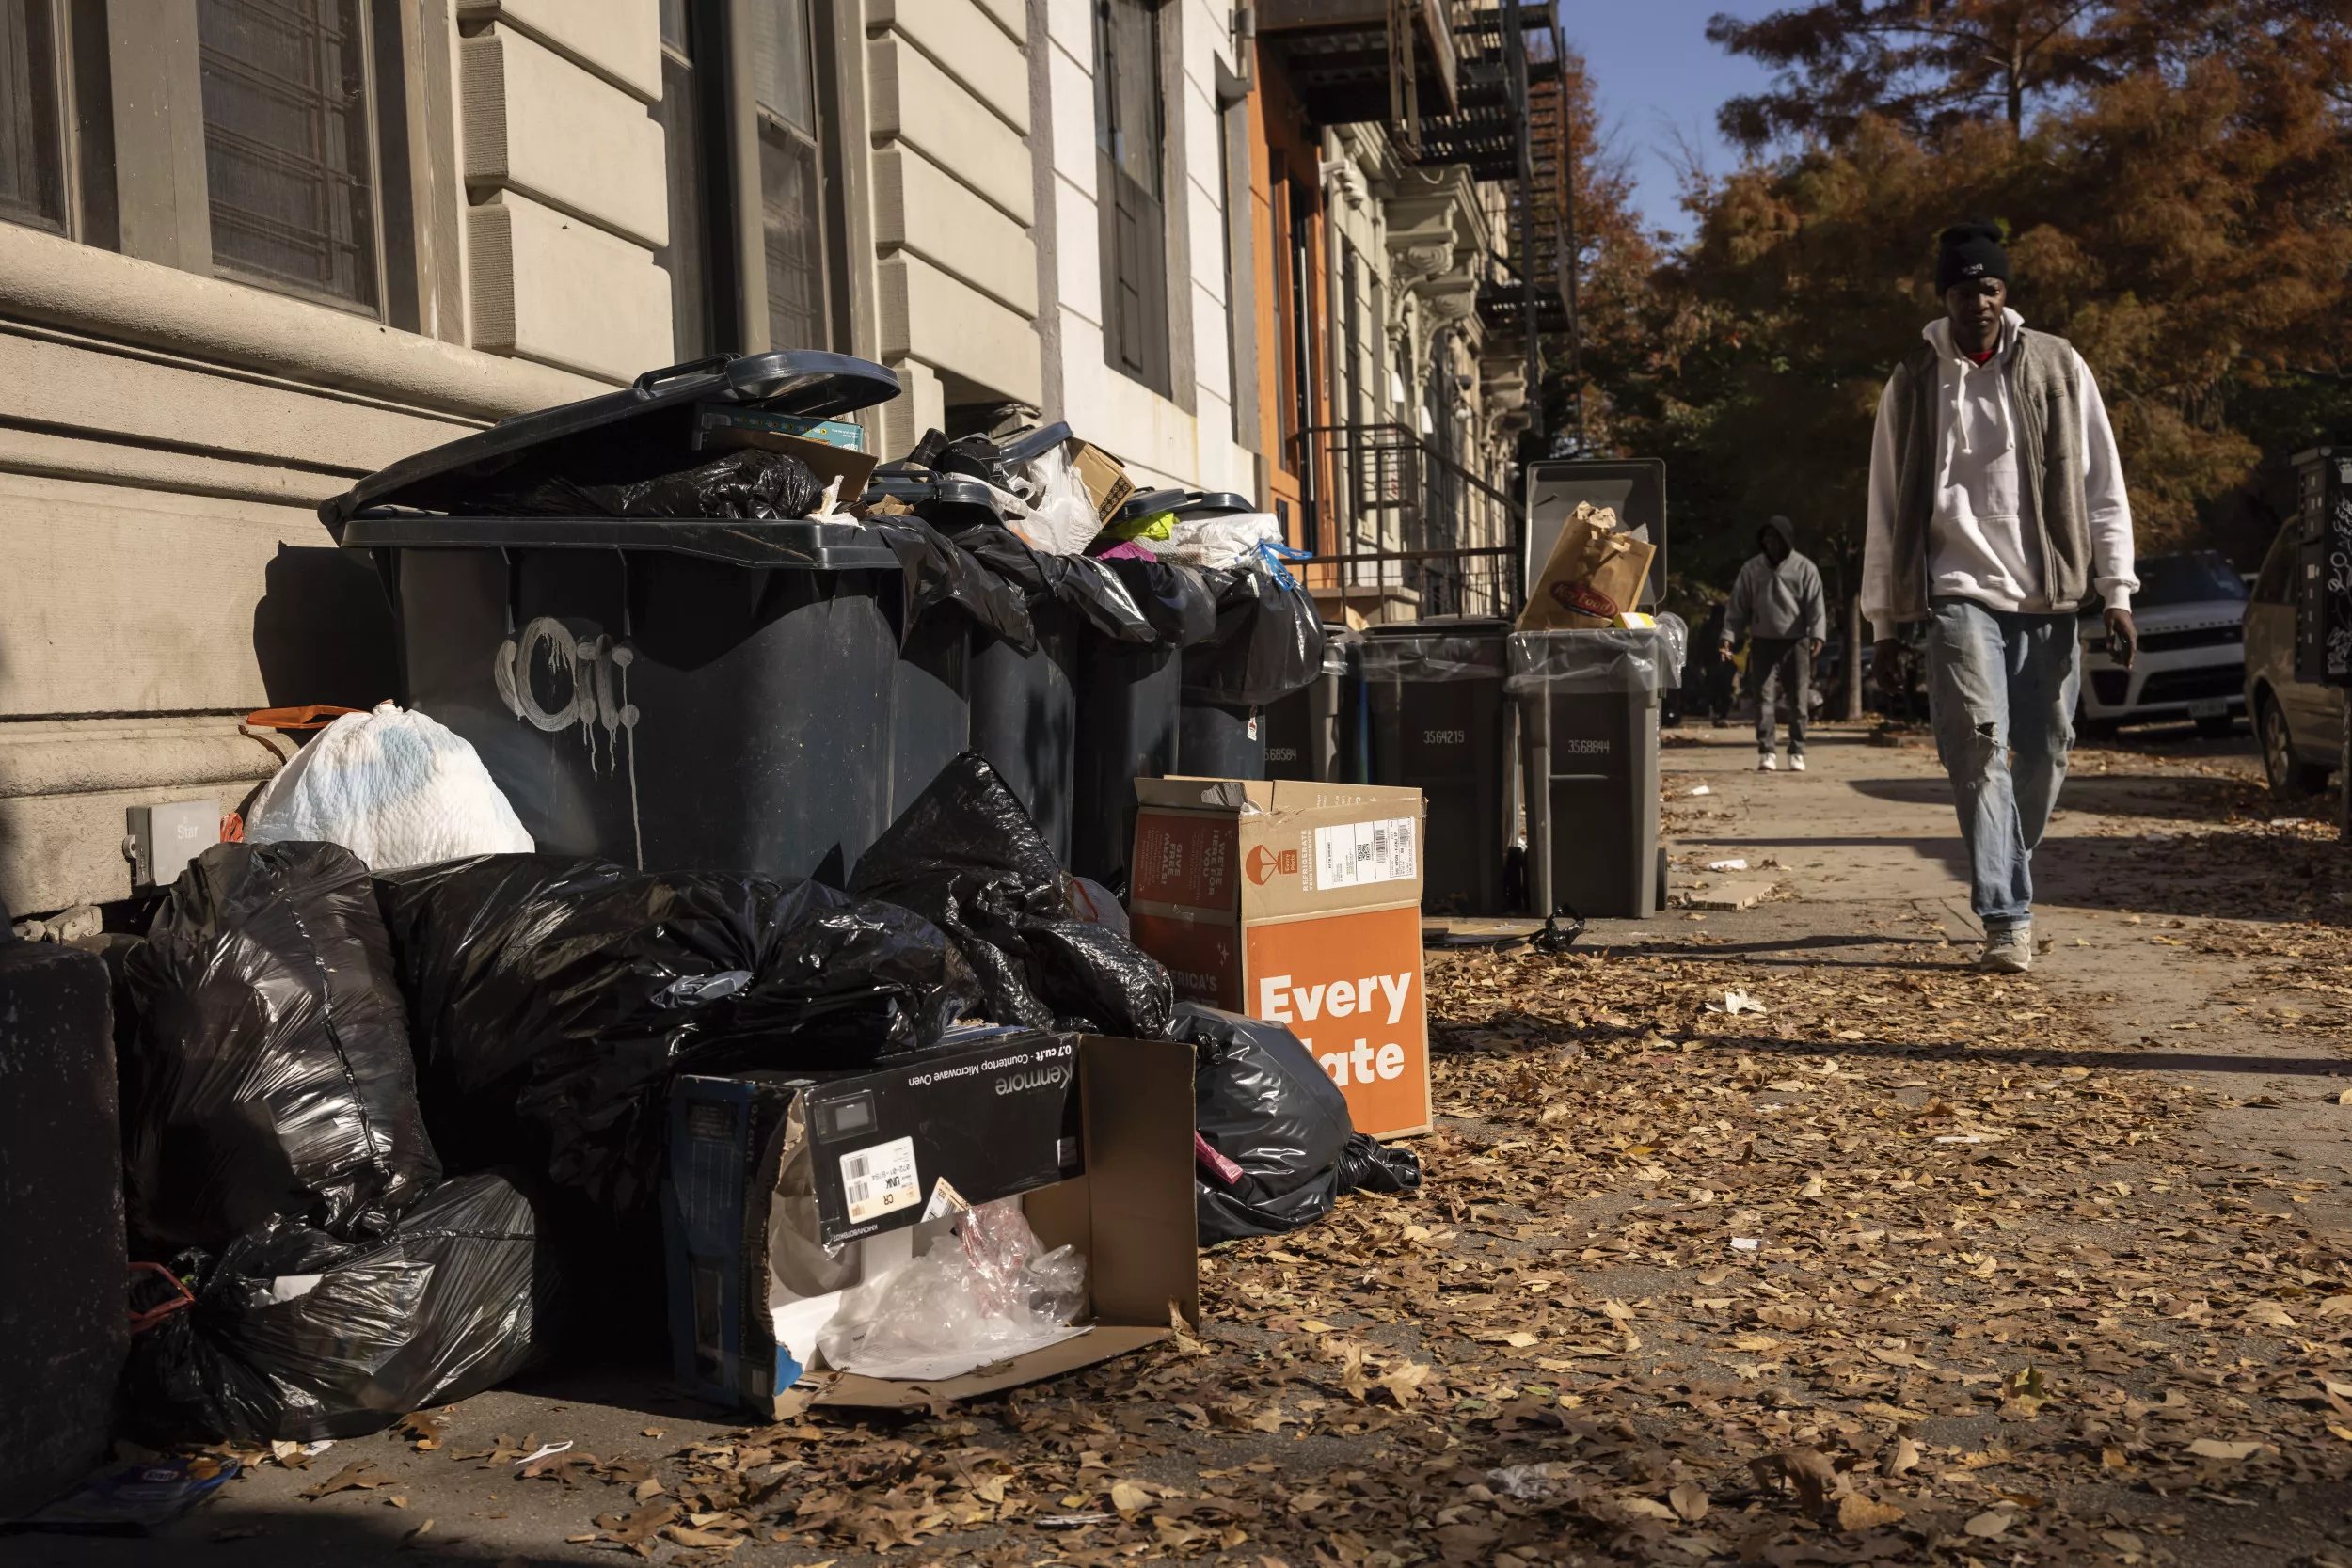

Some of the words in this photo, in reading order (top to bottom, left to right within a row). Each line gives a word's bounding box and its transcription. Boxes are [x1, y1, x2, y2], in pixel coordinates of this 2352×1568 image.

[1554, 583, 1578, 600] Key
[1578, 592, 1612, 611] Food
[1423, 730, 1465, 744] 3564219
[1567, 739, 1611, 753] 3568844
[1264, 748, 1296, 761] 568584
[177, 824, 199, 840] Star
[1211, 829, 1219, 865] HERE
[1161, 832, 1170, 885] MEALS!
[1168, 843, 1176, 876] FREE
[1174, 844, 1183, 877] GIVE
[1202, 847, 1211, 878] YOU
[1216, 842, 1226, 887] WE'RE
[1208, 868, 1216, 896] FOR
[1169, 969, 1217, 992] ERICA'S
[1260, 972, 1412, 1024] Every
[1035, 1047, 1057, 1062] cu.ft
[1057, 1044, 1072, 1057] 0.7
[981, 1053, 1029, 1070] Countertop
[1299, 1038, 1405, 1087] ate
[908, 1074, 932, 1087] Oven
[934, 1064, 979, 1082] Microwave
[995, 1063, 1073, 1096] Kenmore
[884, 1175, 900, 1189] UNK
[883, 1194, 894, 1205] CR
[146, 1470, 174, 1481] Kraft
